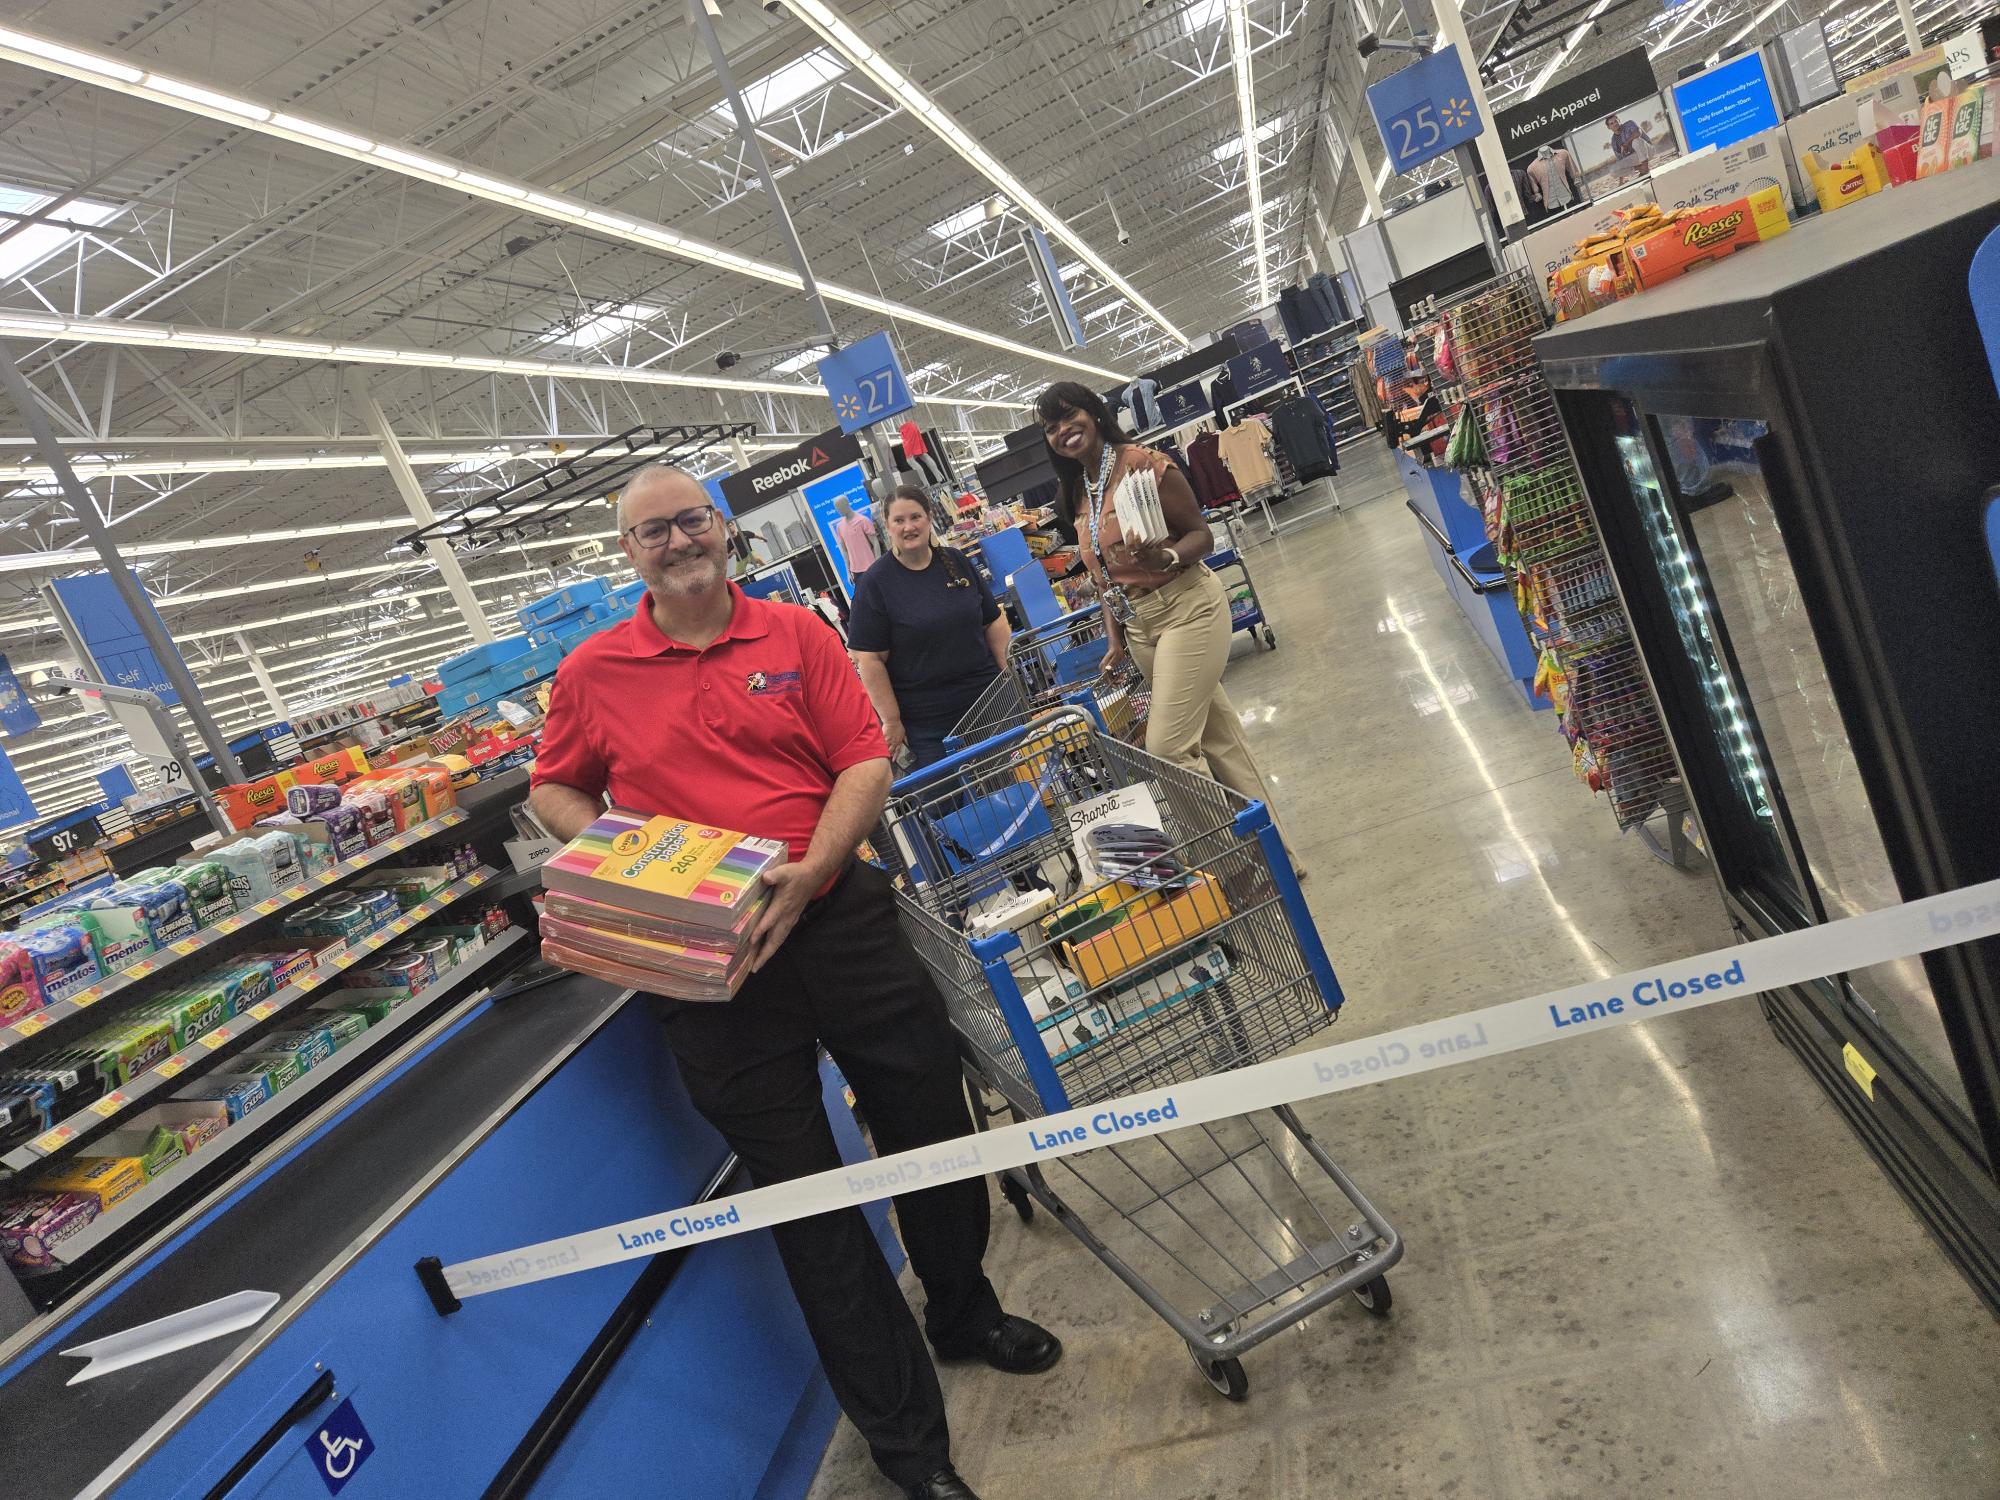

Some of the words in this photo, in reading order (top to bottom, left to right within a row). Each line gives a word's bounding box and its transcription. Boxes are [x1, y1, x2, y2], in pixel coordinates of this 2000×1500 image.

[1510, 115, 1547, 140] Men's
[1550, 88, 1600, 122] Apparel
[1698, 113, 1711, 124] Daily
[1926, 115, 1938, 130] tic
[1960, 105, 1972, 119] tic
[1392, 106, 1440, 159] 25
[1824, 122, 1855, 137] PREMIUM
[1955, 120, 1970, 133] tac
[1808, 140, 1836, 154] Bath
[1689, 178, 1720, 194] PREMIUM
[1704, 182, 1740, 202] Sponge
[1684, 210, 1744, 246] Reese's
[1545, 256, 1572, 272] Bath
[859, 370, 894, 414] 27
[752, 458, 812, 494] Reebok
[117, 670, 140, 684] Self
[160, 761, 182, 784] 29
[1070, 798, 1120, 832] Sharpie
[622, 823, 688, 878] Construction
[656, 835, 689, 862] paper
[671, 854, 698, 874] 240
[206, 894, 233, 914] BREAKERS
[165, 912, 192, 936] BREAKERS
[173, 925, 192, 940] CUBES
[106, 937, 150, 965] mentos
[46, 963, 96, 995] mentos
[274, 958, 310, 984] mentos
[236, 976, 270, 1014] Extra
[1550, 996, 1624, 1030] Lane
[1632, 960, 1746, 1007] Closed
[185, 1002, 222, 1044] Extra
[128, 1036, 170, 1076] Extra
[279, 1066, 298, 1088] Extra
[244, 1089, 264, 1114] Extra
[1028, 1125, 1086, 1152] Lane
[1092, 1098, 1179, 1136] Closed
[618, 1228, 666, 1250] Lane
[670, 1205, 740, 1238] Closed
